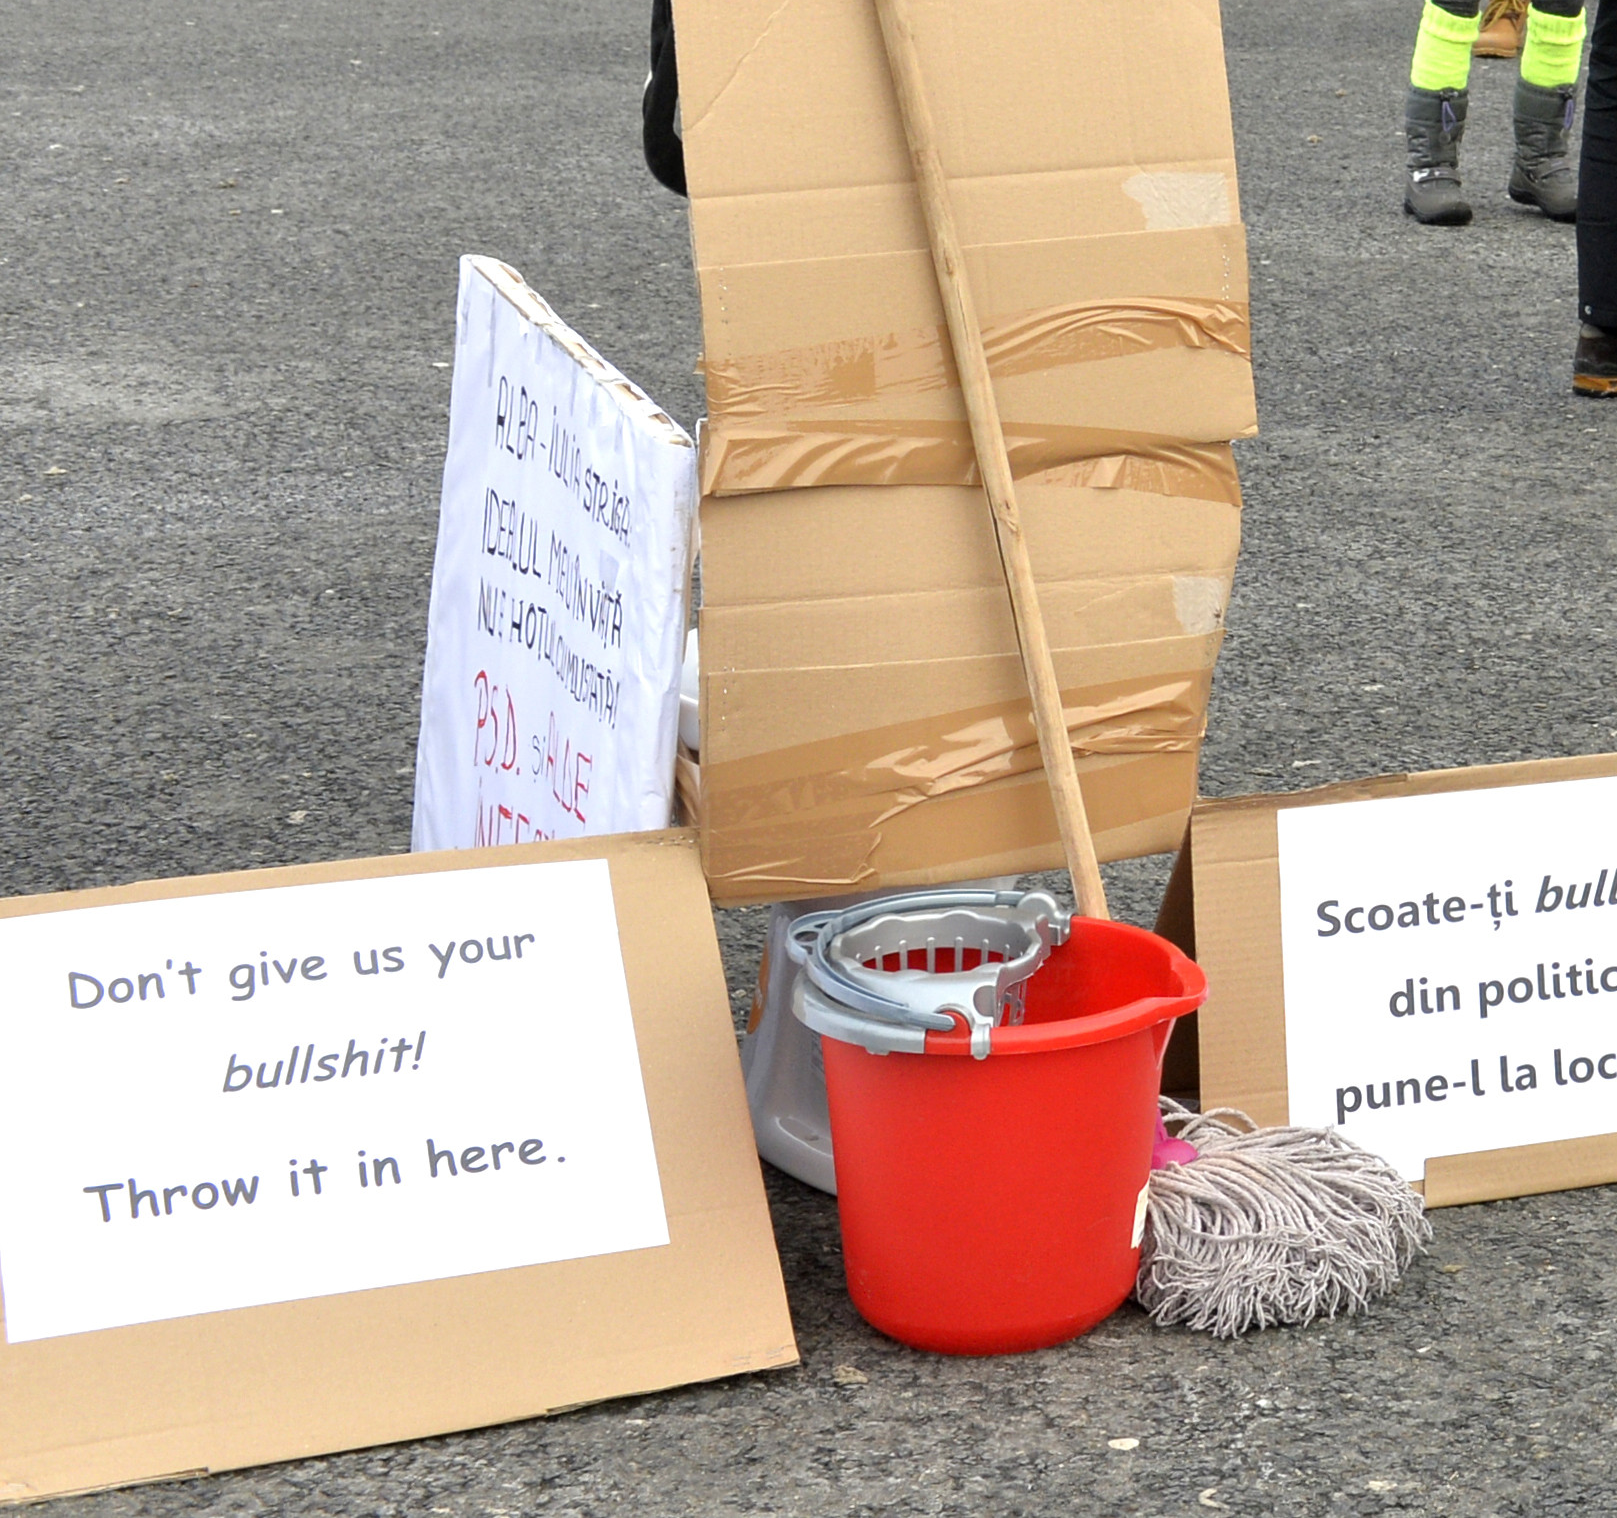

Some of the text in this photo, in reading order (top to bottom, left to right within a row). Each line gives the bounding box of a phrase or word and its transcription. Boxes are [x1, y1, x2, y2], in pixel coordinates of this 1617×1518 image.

[1316, 879, 1519, 938] Scoate-ți
[68, 933, 535, 1009] Don't give us your
[1389, 976, 1461, 1018] din
[222, 1030, 426, 1093] bullshit!
[1335, 1058, 1486, 1126] pune-l
[1499, 1055, 1538, 1093] la
[82, 1138, 566, 1223] Throw it in here.
